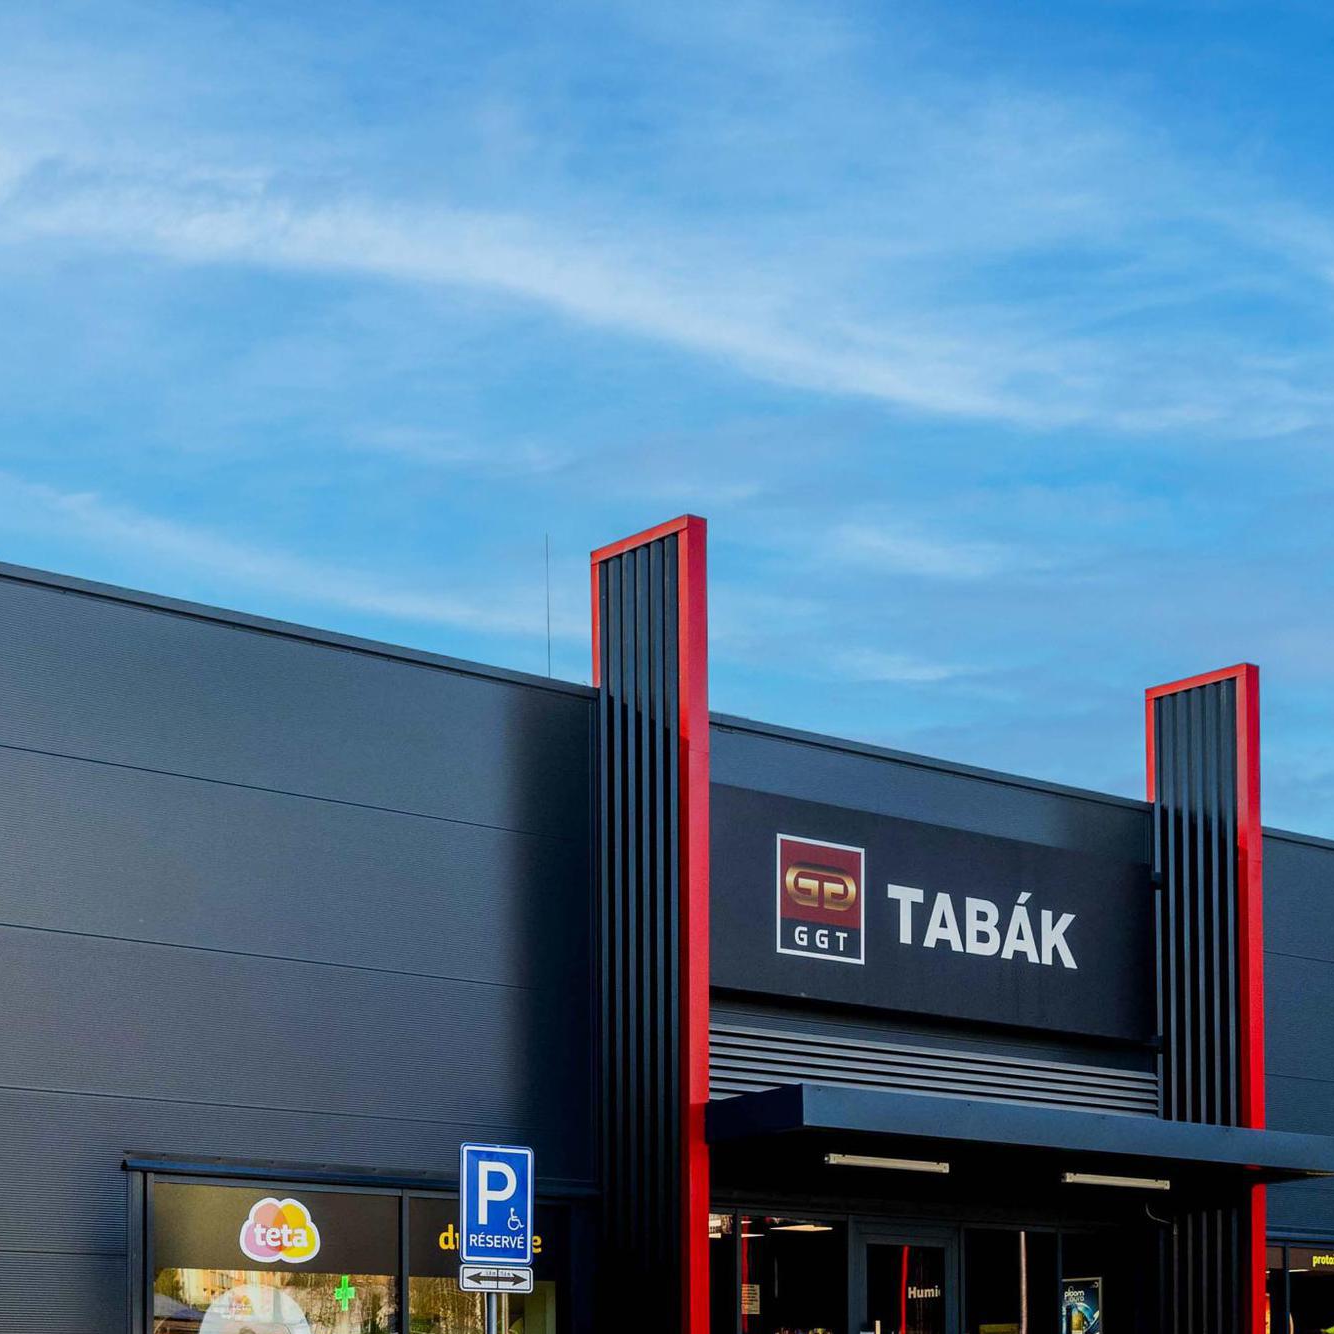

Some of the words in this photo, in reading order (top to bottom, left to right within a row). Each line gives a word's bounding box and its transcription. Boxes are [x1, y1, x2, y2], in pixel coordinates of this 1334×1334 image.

[794, 926, 849, 951] GGT
[887, 884, 1078, 969] TABÁK
[477, 1160, 518, 1225] P
[254, 1224, 308, 1247] teta
[469, 1232, 525, 1250] RÉSERVÉ
